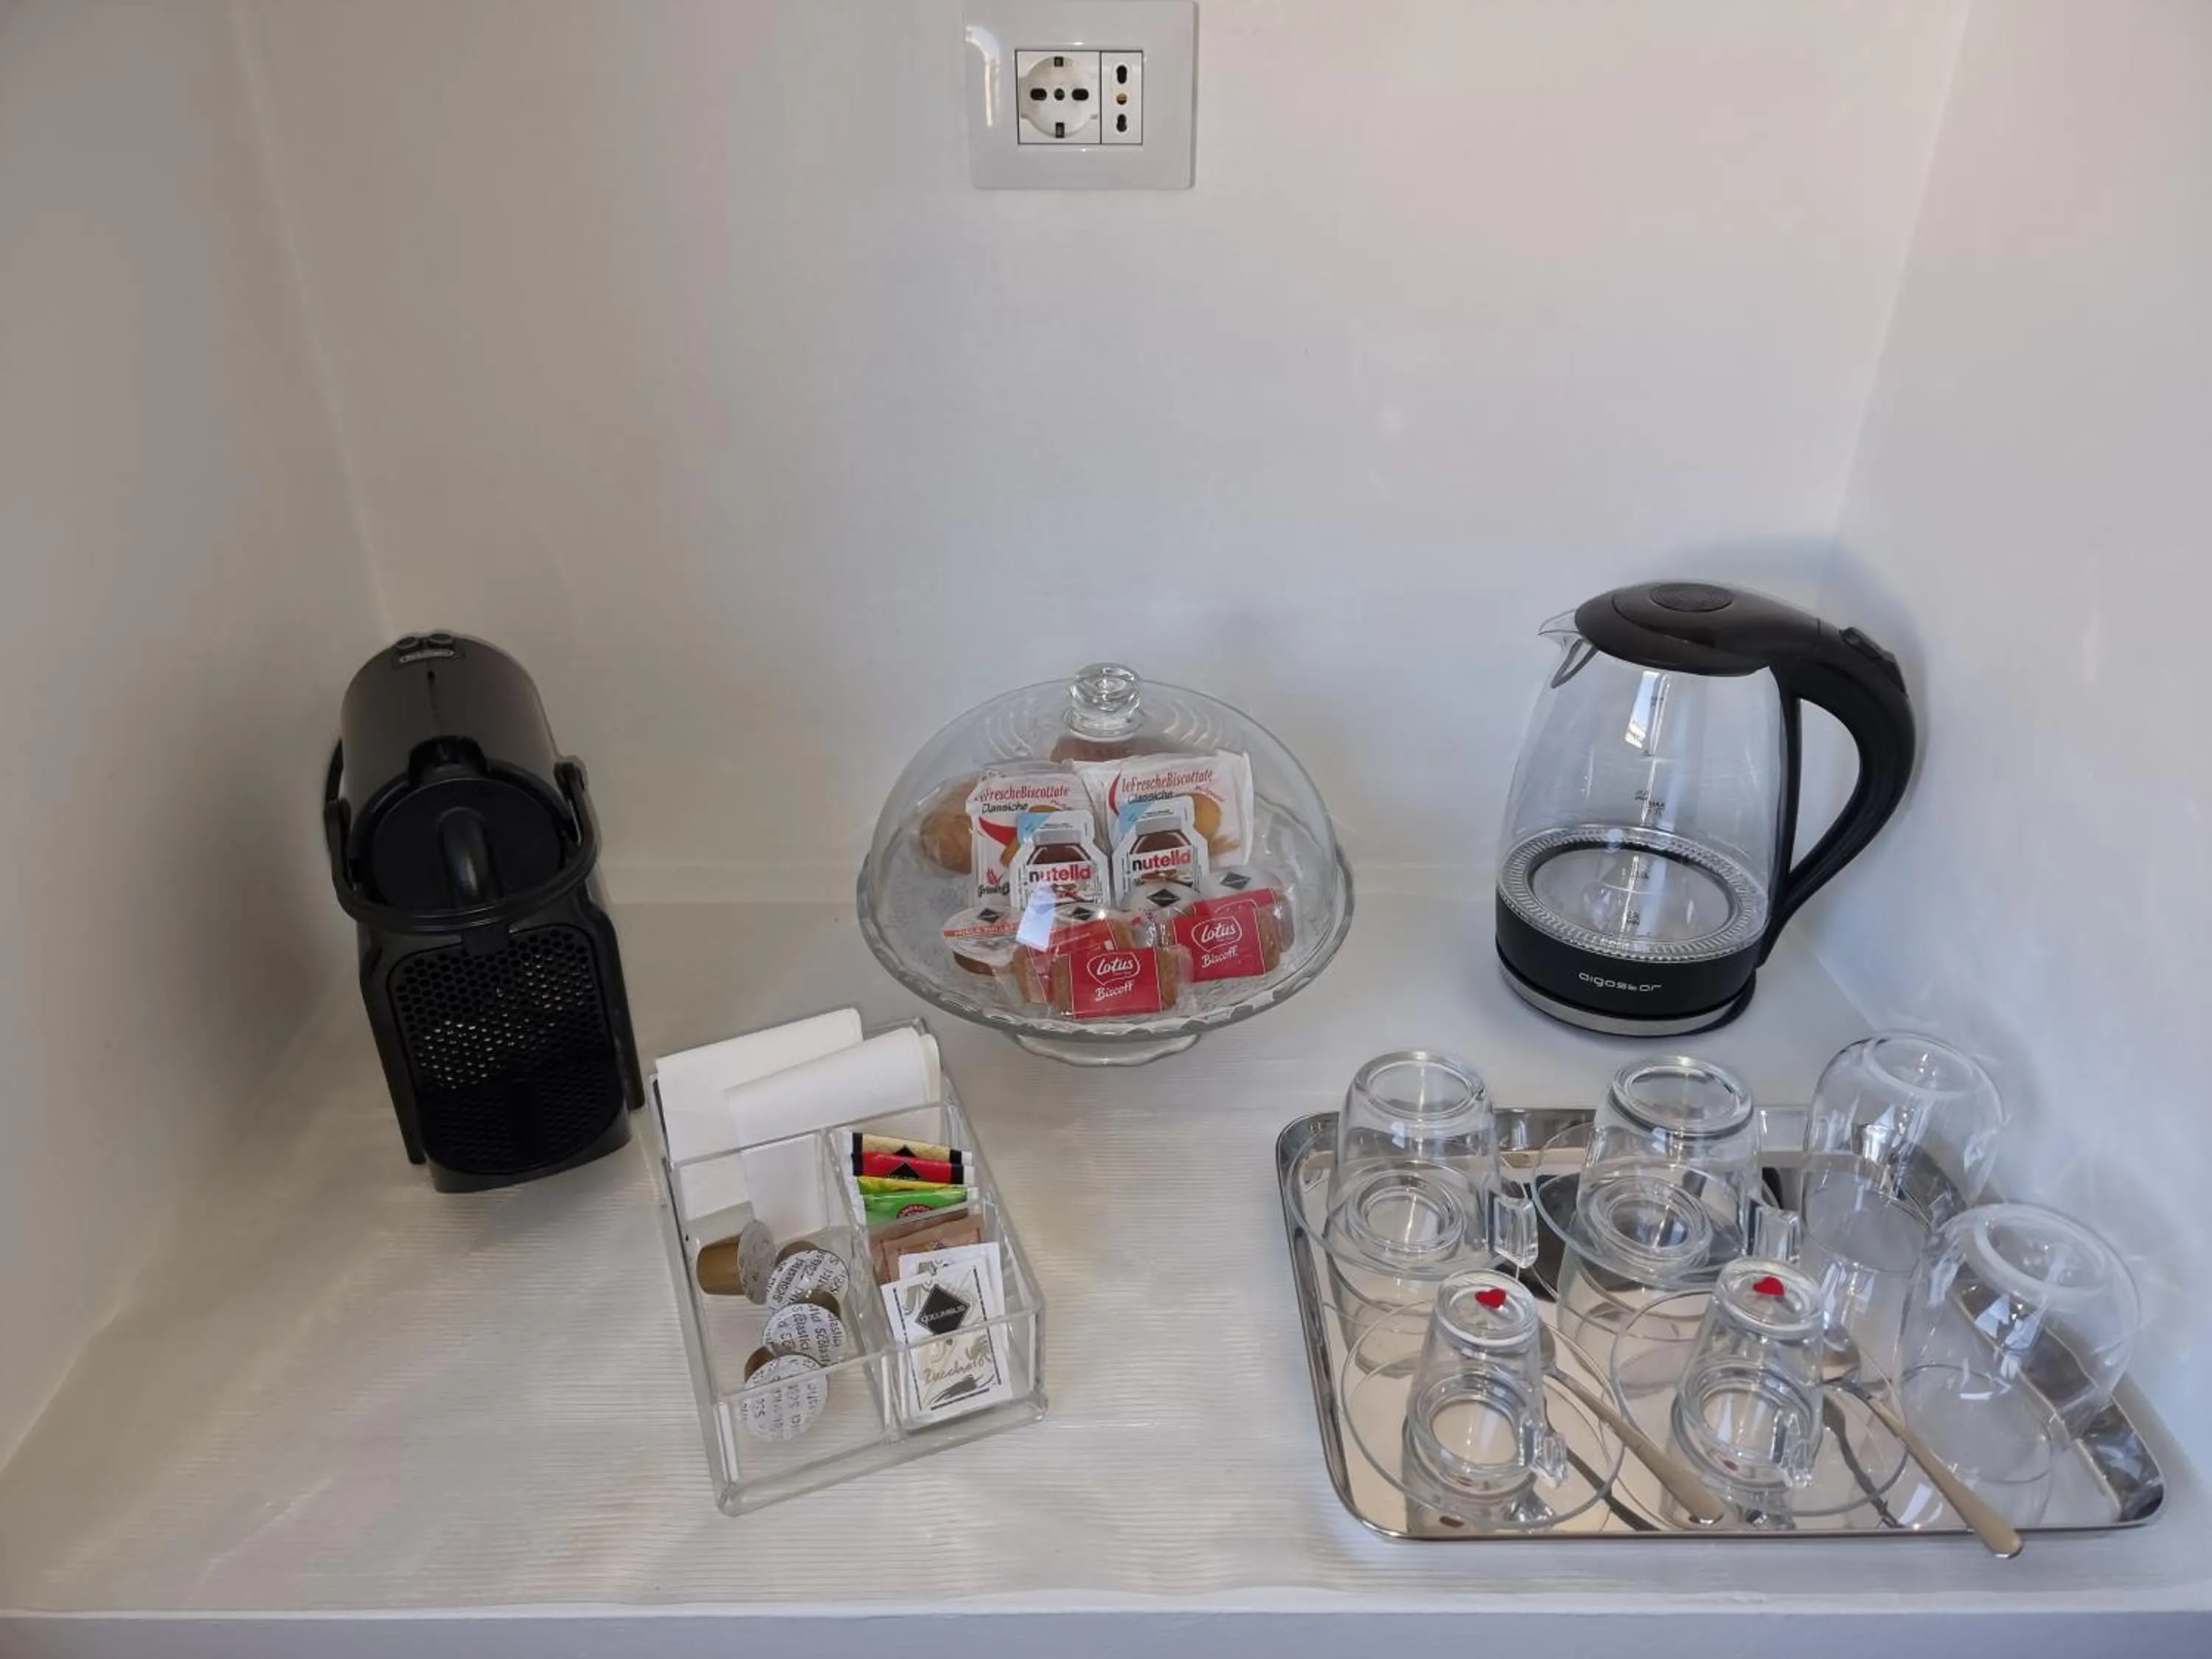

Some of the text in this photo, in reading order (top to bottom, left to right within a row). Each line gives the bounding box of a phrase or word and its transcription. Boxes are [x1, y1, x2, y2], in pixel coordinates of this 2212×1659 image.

[1132, 850, 1192, 872] nutella
[1029, 864, 1092, 883] nutella
[1201, 922, 1237, 944] Lotus
[1096, 958, 1134, 975] Lotus
[1095, 980, 1134, 1002] Biscoff
